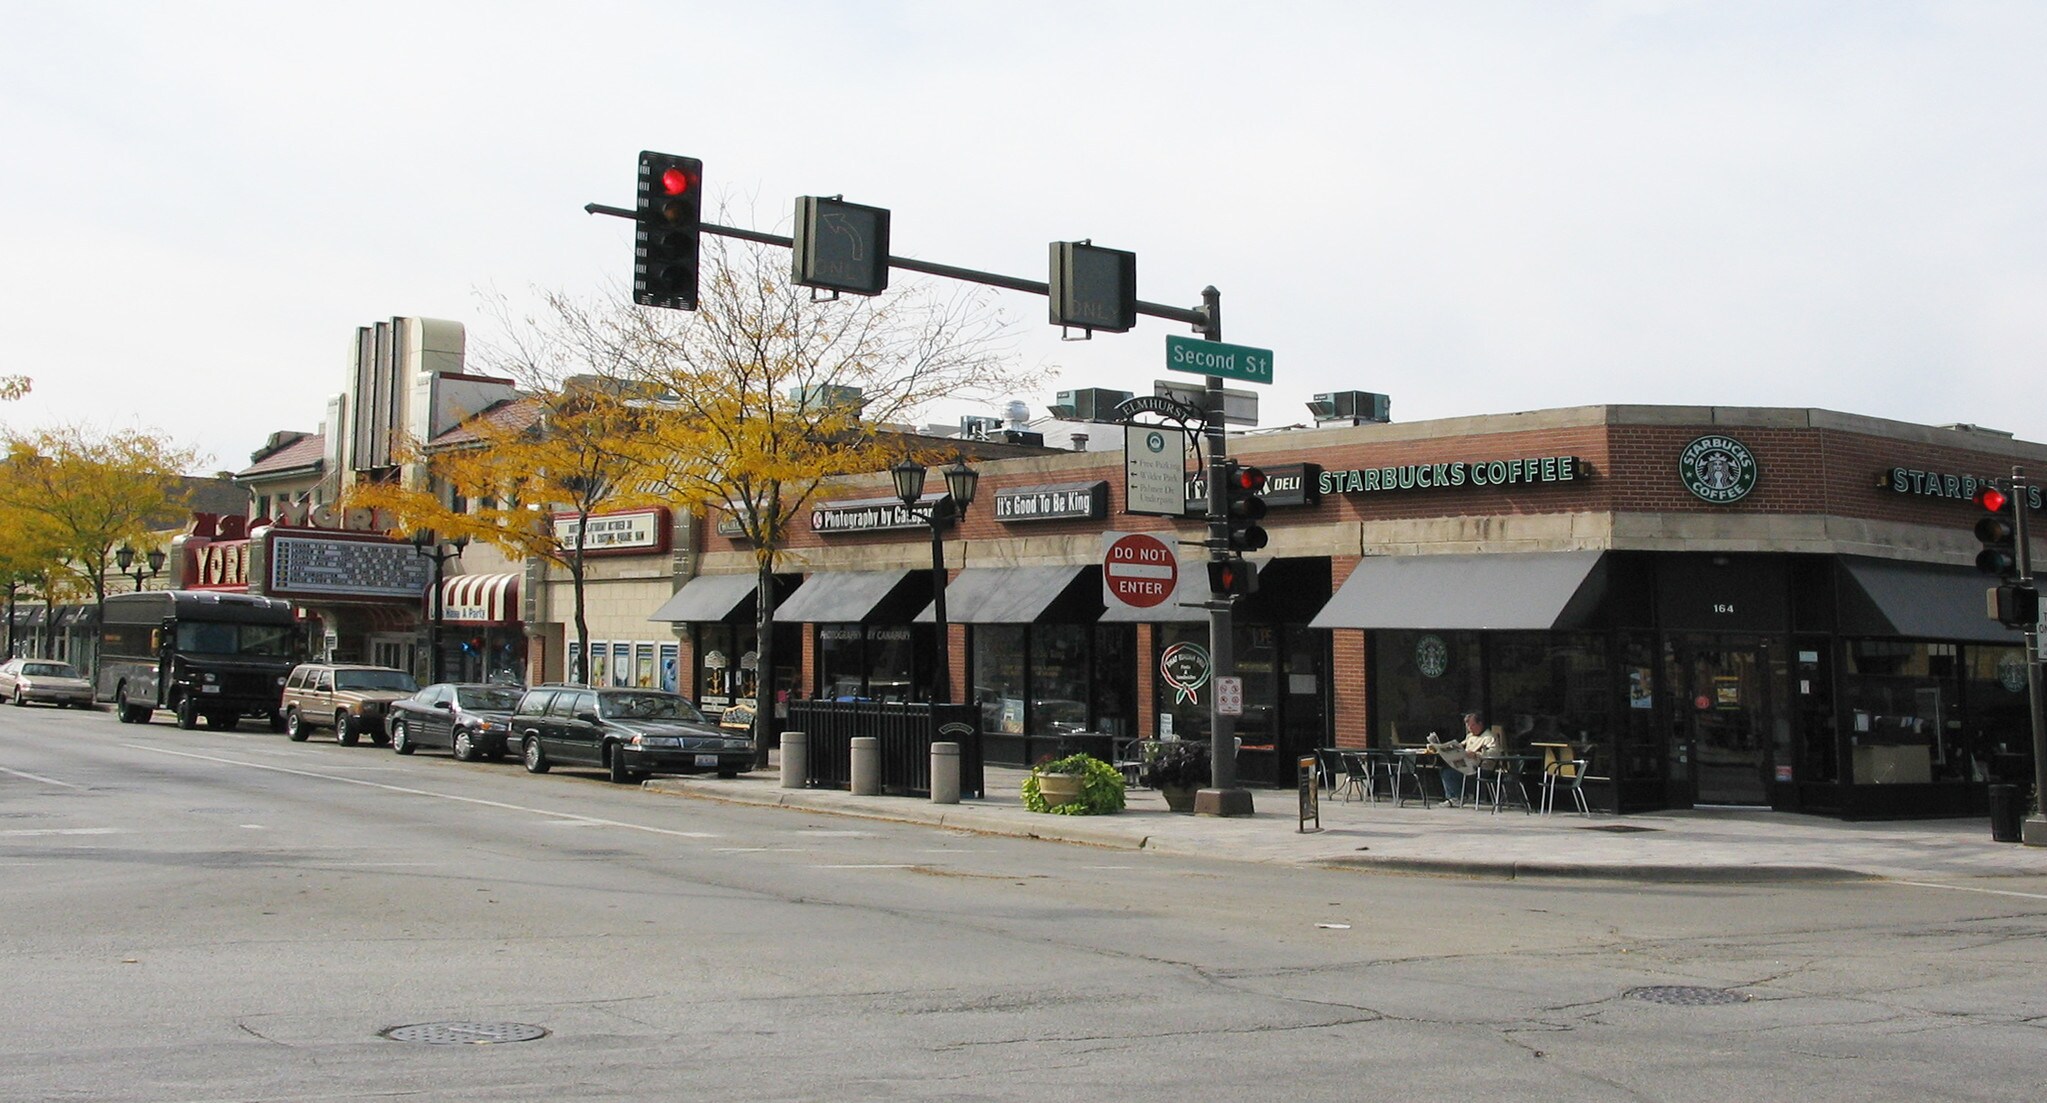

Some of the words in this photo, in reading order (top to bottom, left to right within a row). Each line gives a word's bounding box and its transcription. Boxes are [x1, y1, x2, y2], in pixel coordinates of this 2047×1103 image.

[1173, 344, 1235, 371] Second
[1245, 355, 1267, 376] St
[1122, 399, 1191, 421] ELMHURST
[1683, 438, 1752, 468] STARBUCKS
[1274, 477, 1300, 491] DELI
[1318, 461, 1466, 494] STARBUCKS
[1470, 456, 1574, 486] COFFEE
[1692, 482, 1745, 500] COFFEE
[1893, 467, 2042, 509] STARBS
[997, 496, 1012, 516] It's
[1014, 494, 1037, 515] Good
[1039, 494, 1051, 513] To
[1053, 493, 1066, 512] Be
[1068, 492, 1090, 514] King
[824, 508, 879, 529] Photography
[881, 507, 893, 527] by
[1114, 547, 1134, 559] DO
[1140, 548, 1167, 562] NOT
[1120, 581, 1163, 594] ENTER
[1713, 604, 1734, 613] 164
